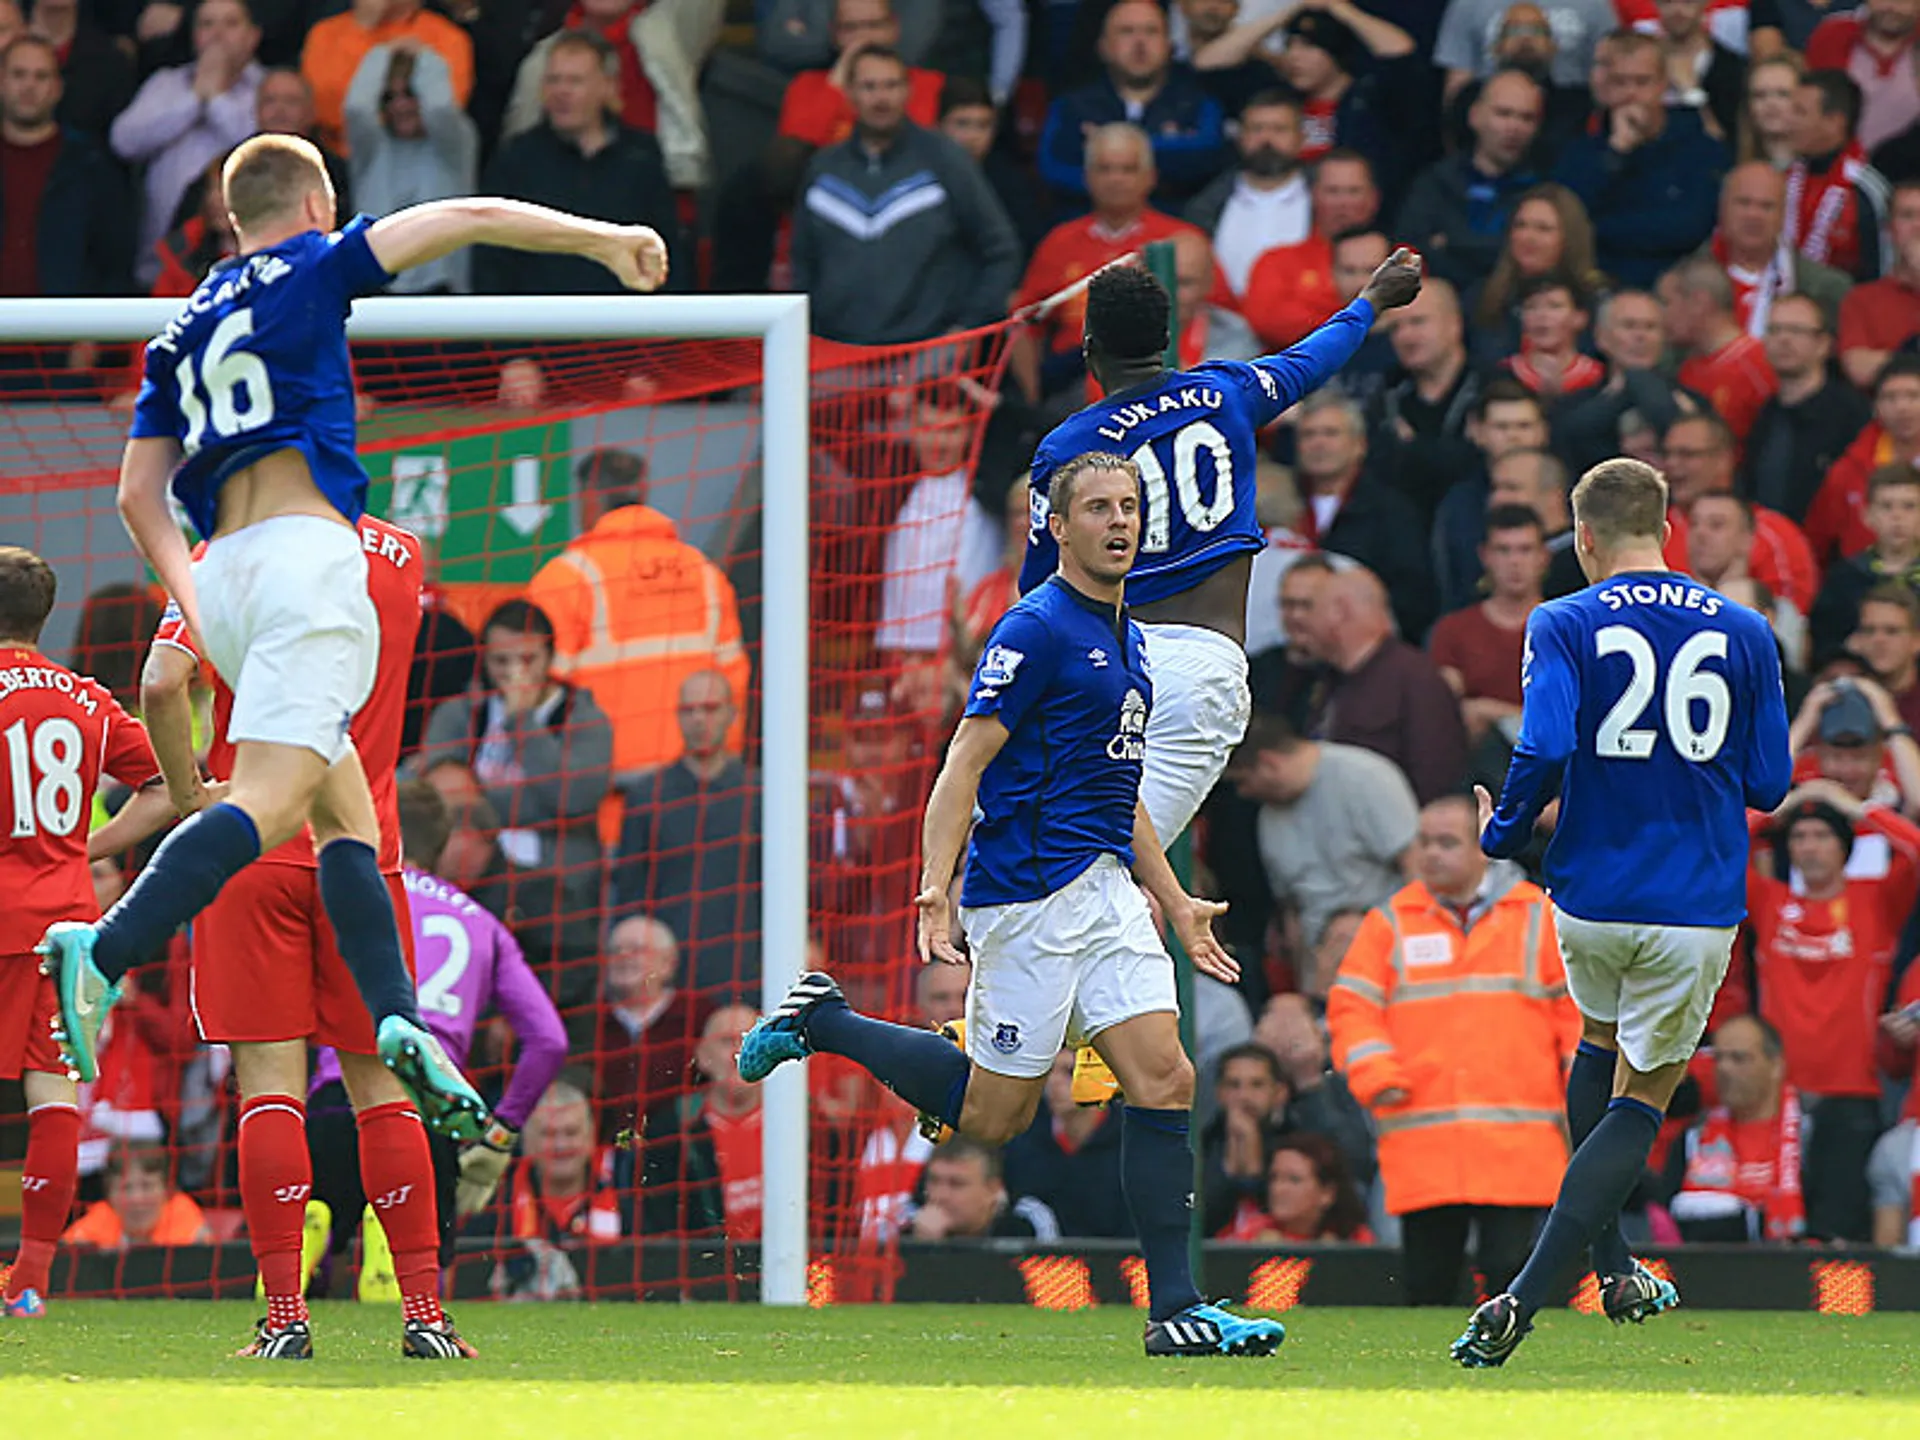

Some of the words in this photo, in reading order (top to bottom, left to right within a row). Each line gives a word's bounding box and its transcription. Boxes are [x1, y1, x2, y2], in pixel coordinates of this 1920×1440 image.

[175, 307, 275, 458] 16
[1098, 387, 1223, 442] LUKAKU
[1130, 419, 1235, 554] 10
[362, 527, 412, 568] ERT
[1598, 583, 1724, 616] STONES
[1595, 624, 1732, 763] 26
[4, 717, 83, 838] 18
[417, 913, 470, 1017] 2
